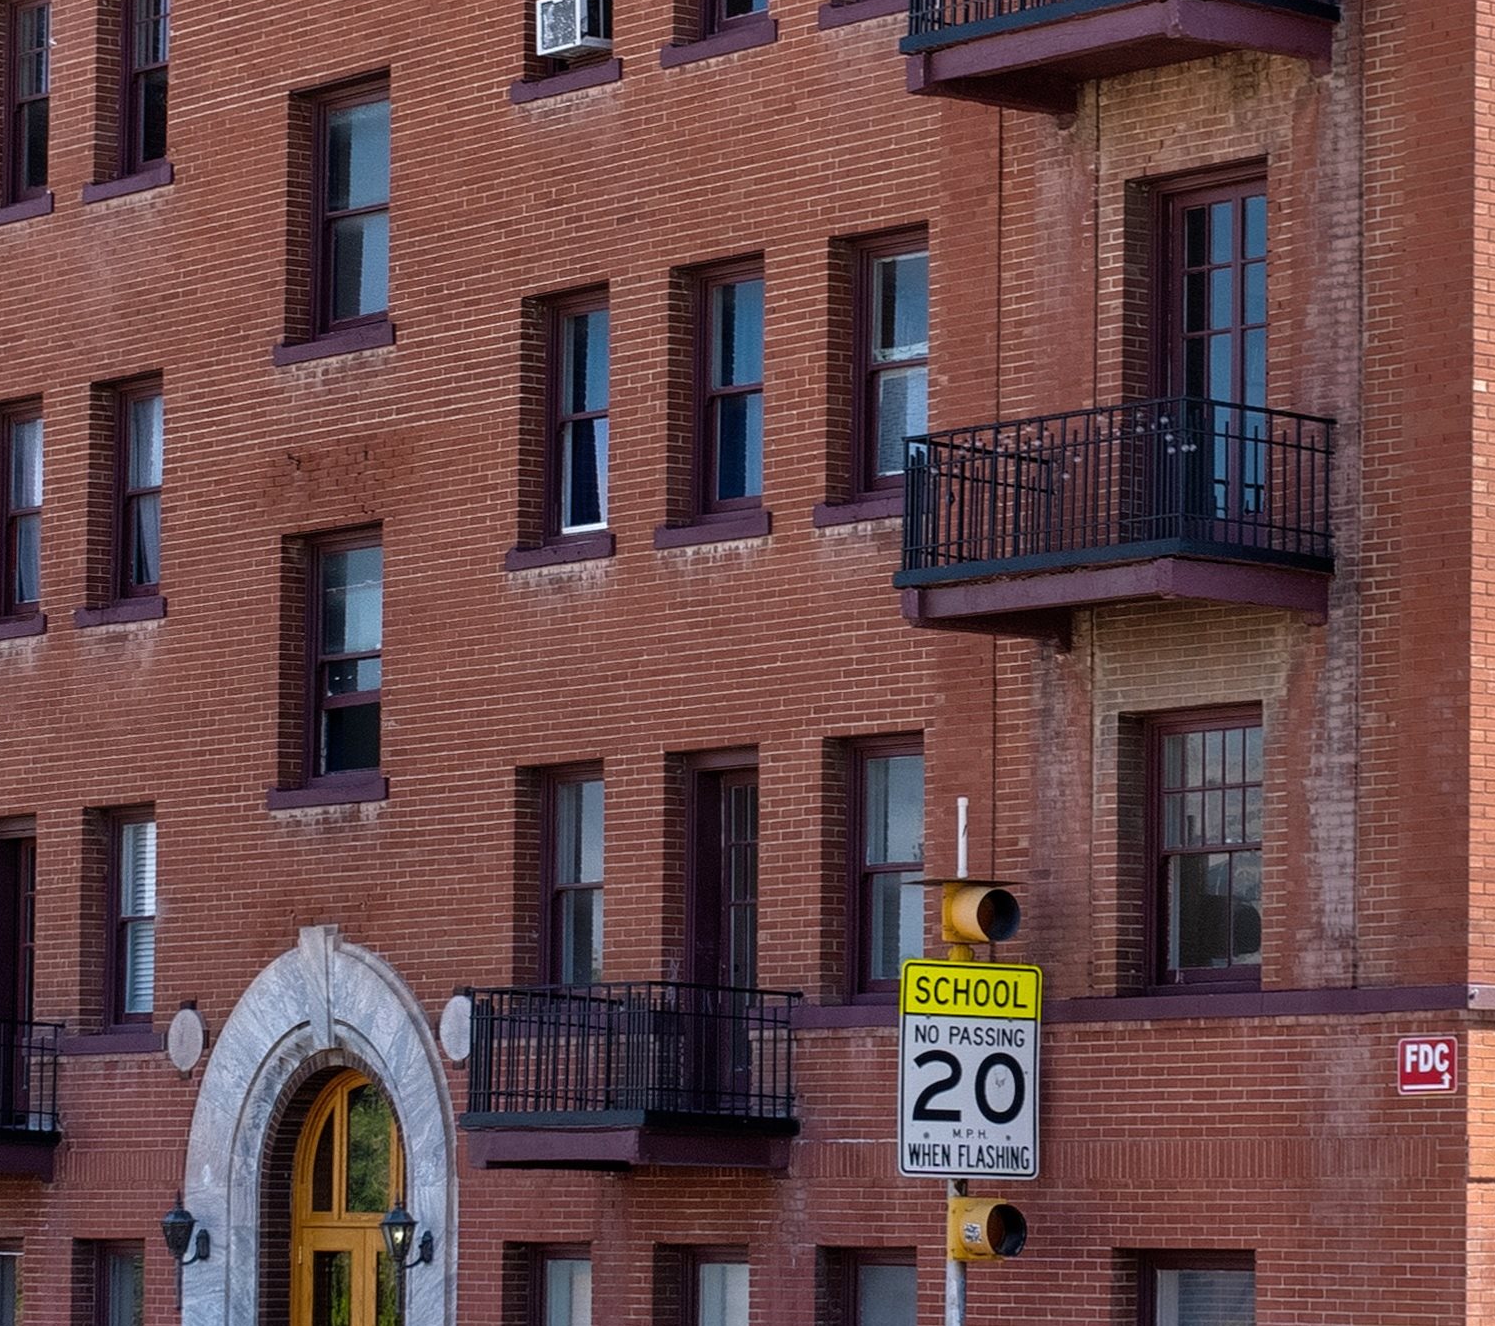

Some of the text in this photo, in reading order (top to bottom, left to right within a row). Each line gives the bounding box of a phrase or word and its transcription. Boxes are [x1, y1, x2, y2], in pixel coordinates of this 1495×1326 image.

[915, 976, 1028, 1008] SCHOOL
[914, 1024, 1026, 1048] NO PASSING
[1405, 1043, 1450, 1073] FDC
[912, 1049, 1026, 1125] 20
[908, 1143, 1030, 1170] WHEN FLASHING
